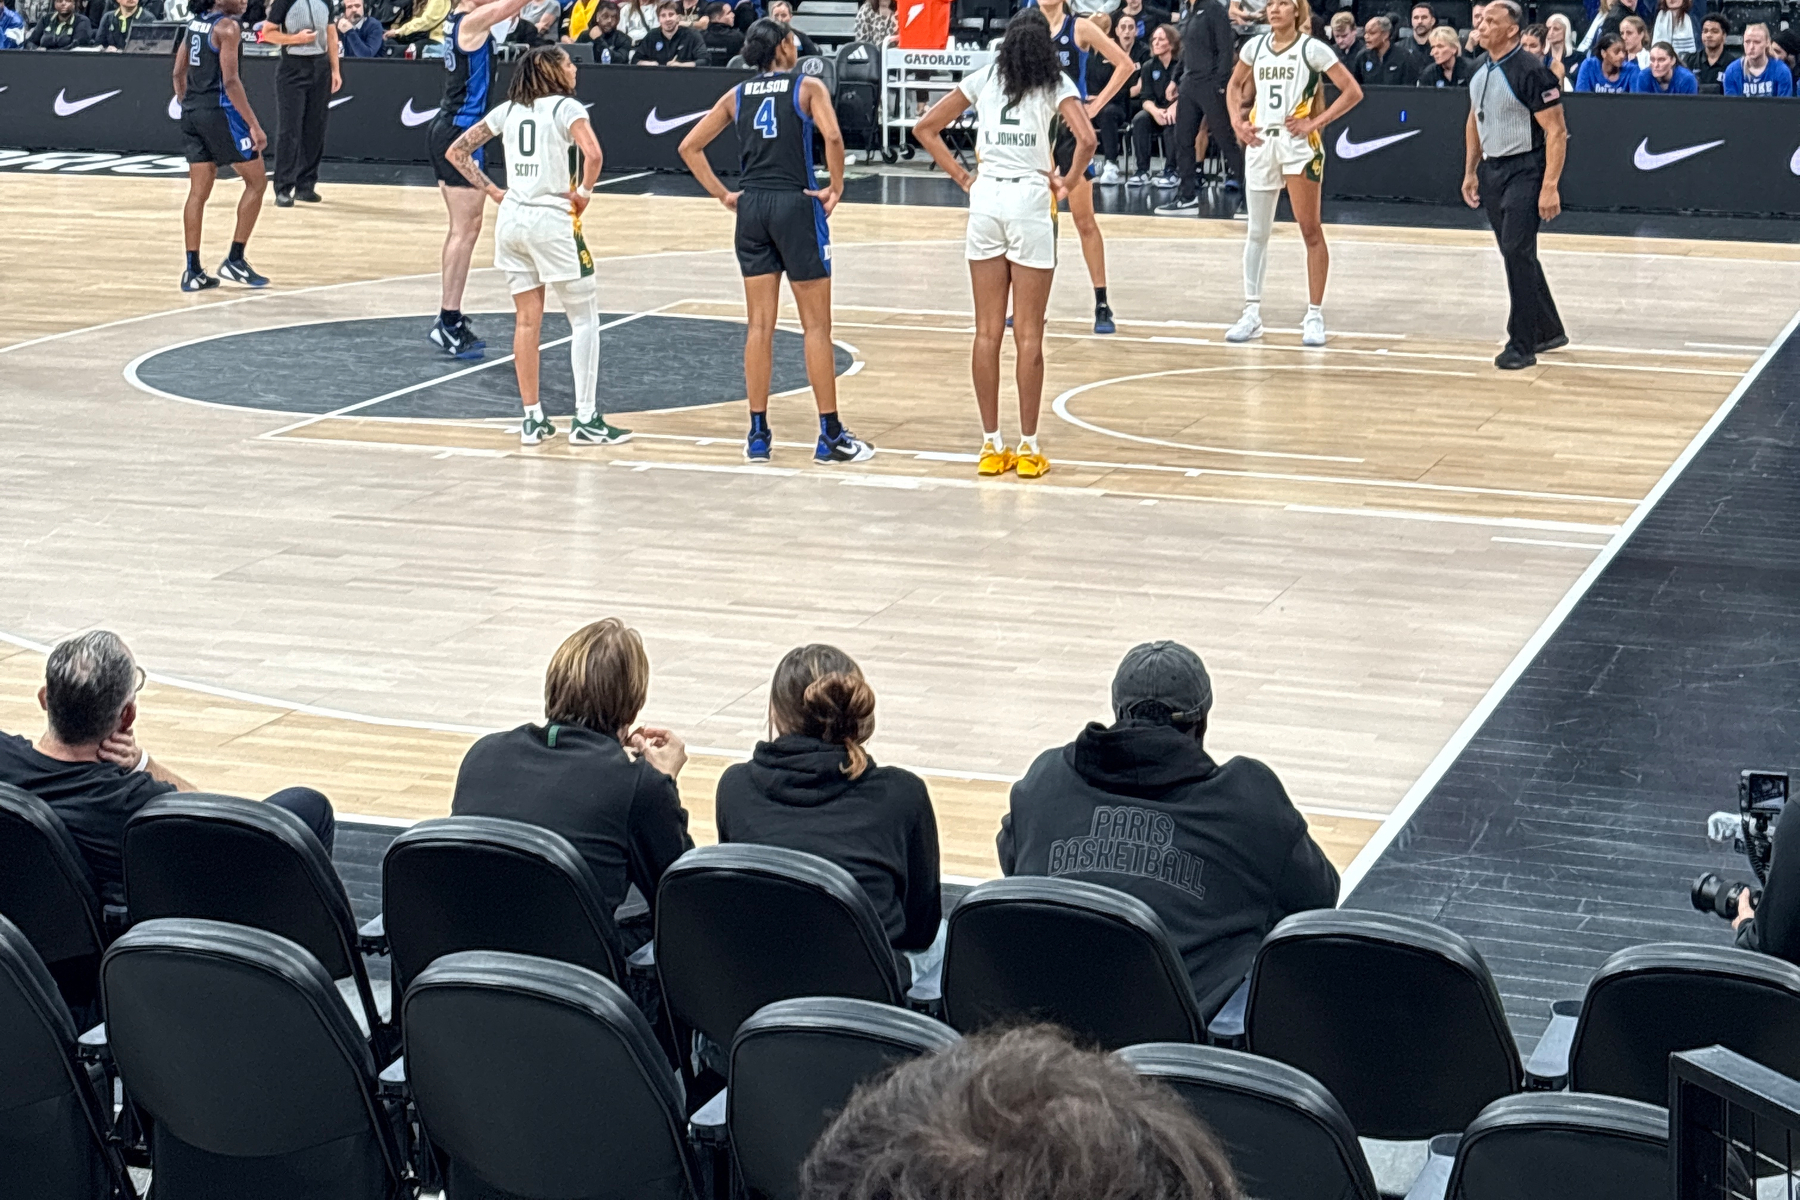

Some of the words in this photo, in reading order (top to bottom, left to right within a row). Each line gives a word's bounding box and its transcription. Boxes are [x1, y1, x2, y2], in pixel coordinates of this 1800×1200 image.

[188, 33, 202, 67] 2
[904, 53, 971, 67] GATORADE
[1259, 66, 1295, 81] BEARS
[744, 79, 790, 96] NELSON
[1268, 84, 1283, 110] 5
[753, 96, 778, 139] 4
[518, 118, 536, 157] 0
[995, 131, 1037, 148] JOHNSON
[514, 162, 540, 178] SCOTT
[1090, 806, 1175, 848] PARIS
[1047, 836, 1207, 900] BASKETBALL
